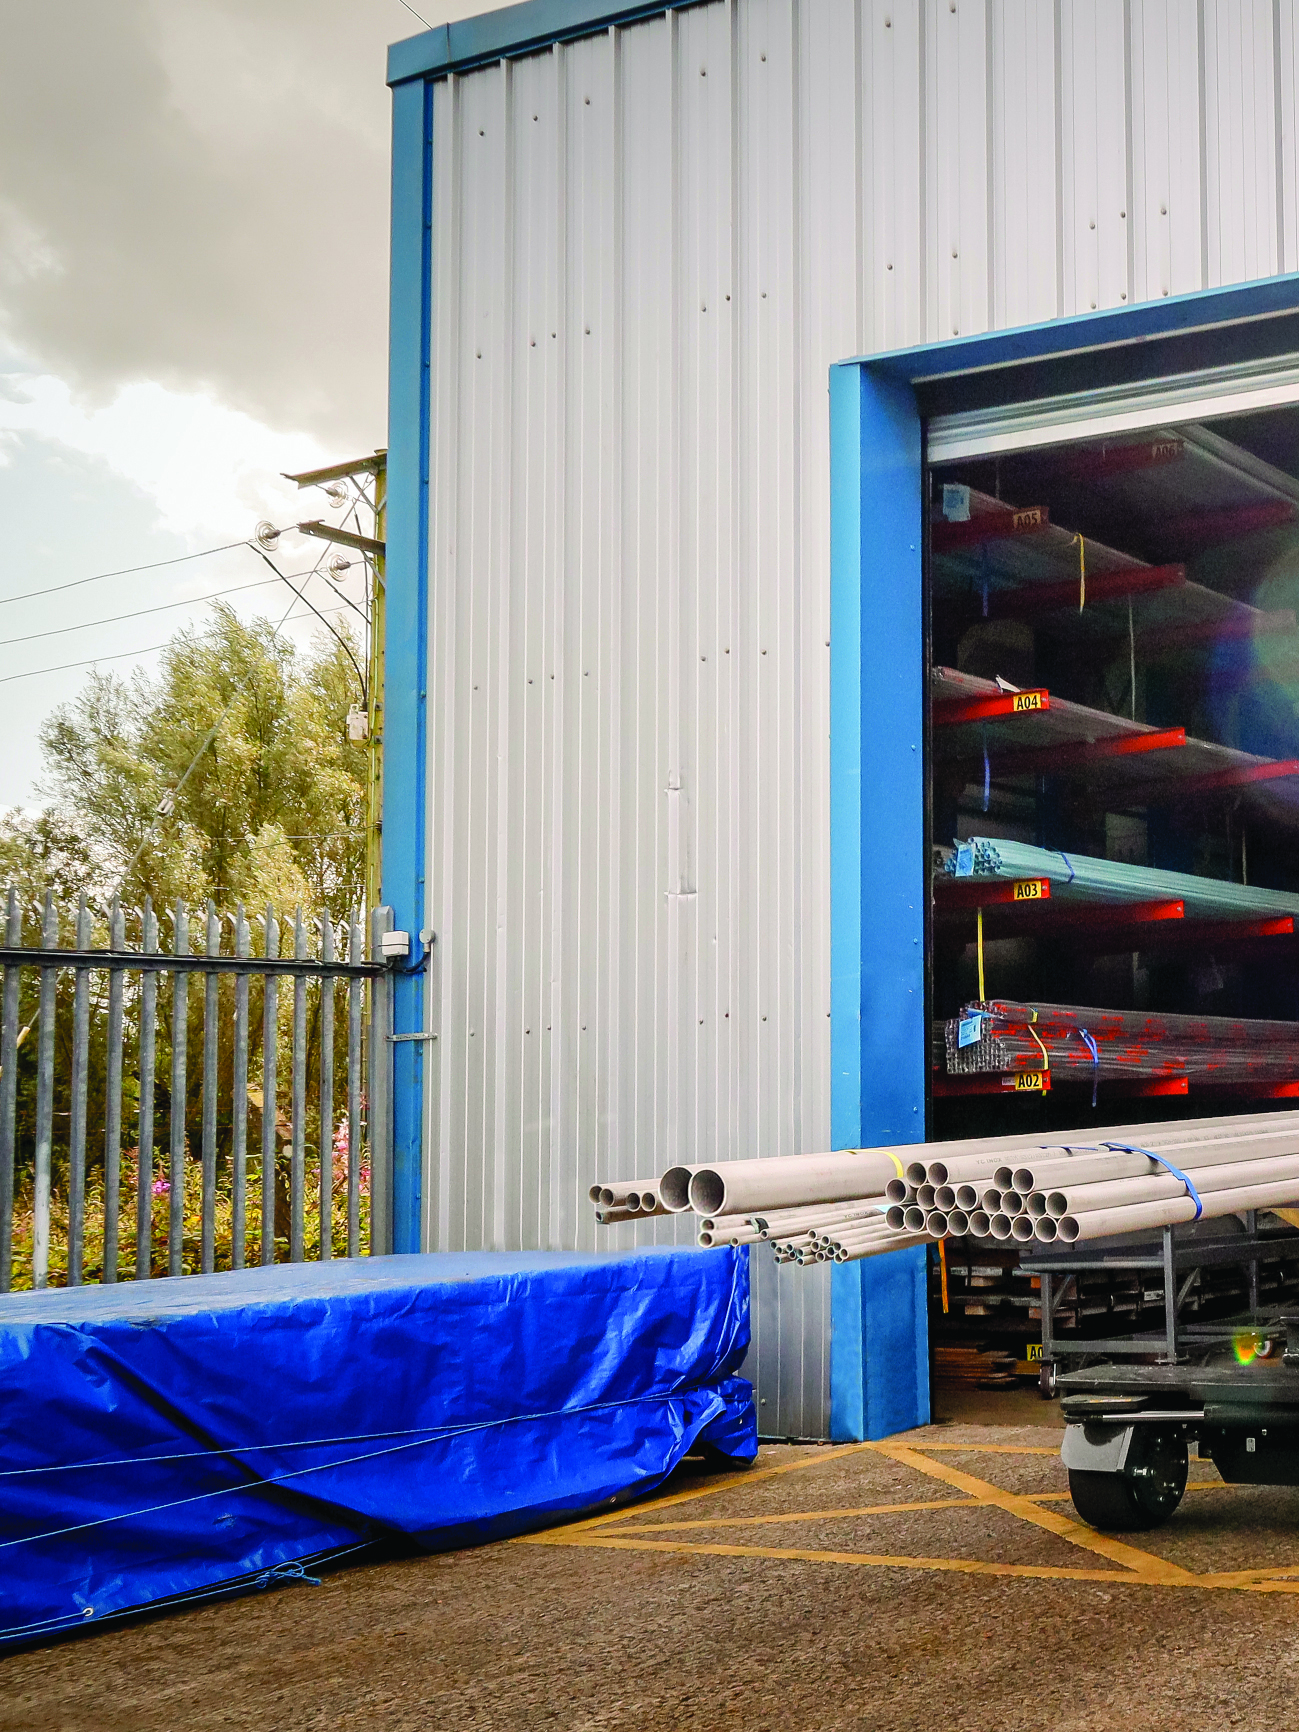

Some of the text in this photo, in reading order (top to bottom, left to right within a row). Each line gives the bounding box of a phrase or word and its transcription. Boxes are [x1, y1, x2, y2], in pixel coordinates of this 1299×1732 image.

[1016, 511, 1038, 527] A05
[1017, 694, 1038, 710] A04
[1017, 883, 1038, 898] A03
[1019, 1074, 1040, 1088] A02
[1030, 1345, 1044, 1360] A0
